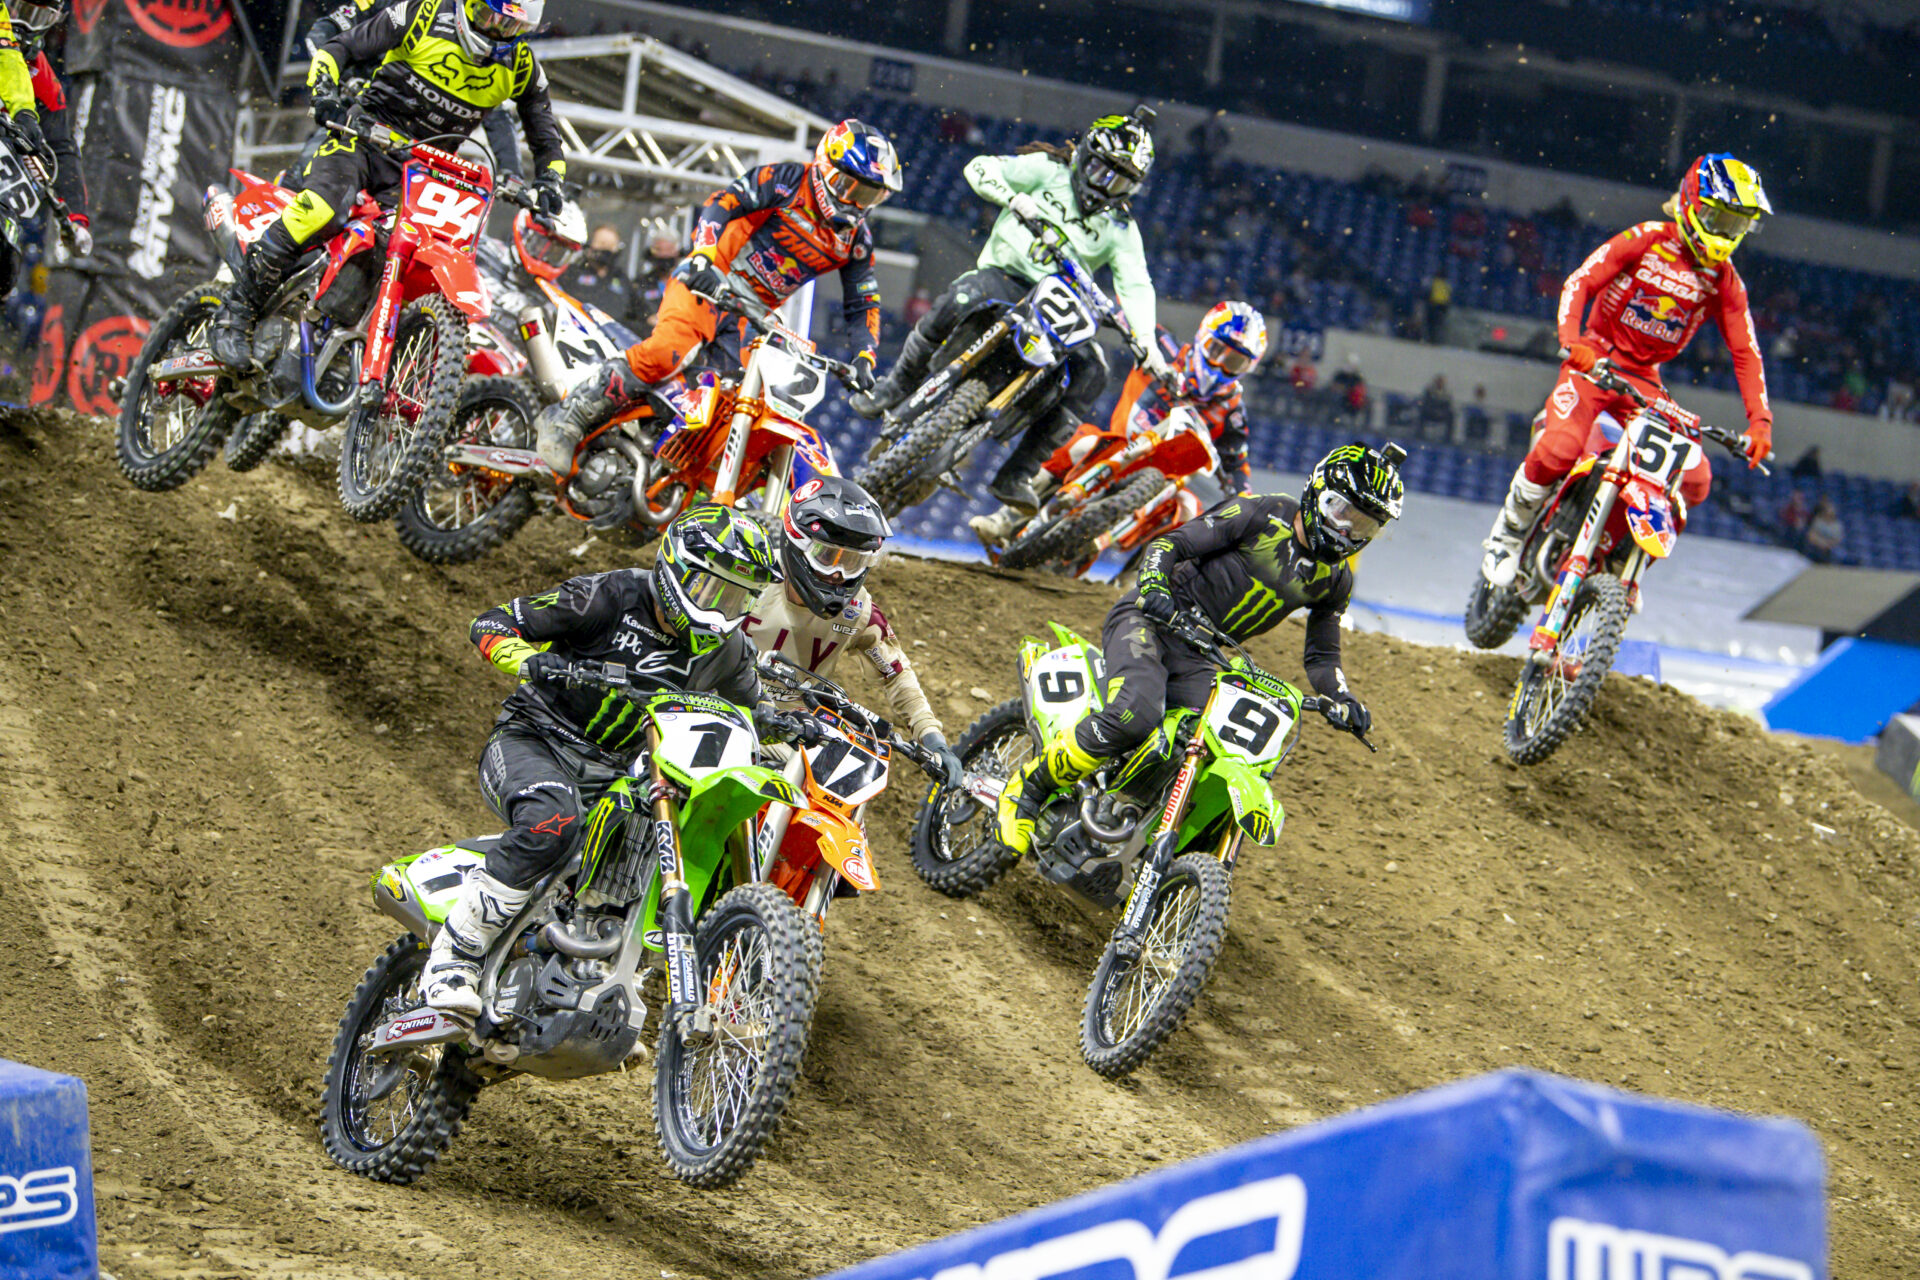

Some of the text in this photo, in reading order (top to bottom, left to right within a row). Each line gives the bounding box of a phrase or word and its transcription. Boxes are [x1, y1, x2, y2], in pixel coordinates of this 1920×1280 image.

[405, 73, 482, 121] HONDA
[410, 181, 482, 241] 94
[772, 224, 833, 271] THOR
[769, 361, 819, 412] 2
[1631, 423, 1692, 484] 51
[622, 613, 674, 647] Kawasaki
[1038, 671, 1085, 703] 9
[689, 722, 733, 768] 1
[1218, 697, 1280, 757] 9
[810, 740, 887, 798] 17
[822, 794, 844, 809] KTM
[1161, 768, 1188, 823] SHOWA
[1124, 860, 1152, 926] DUNLOP
[666, 932, 682, 1004] DUNLOP
[684, 955, 696, 1002] CARRILLO
[387, 1016, 435, 1040] RENTHAL
